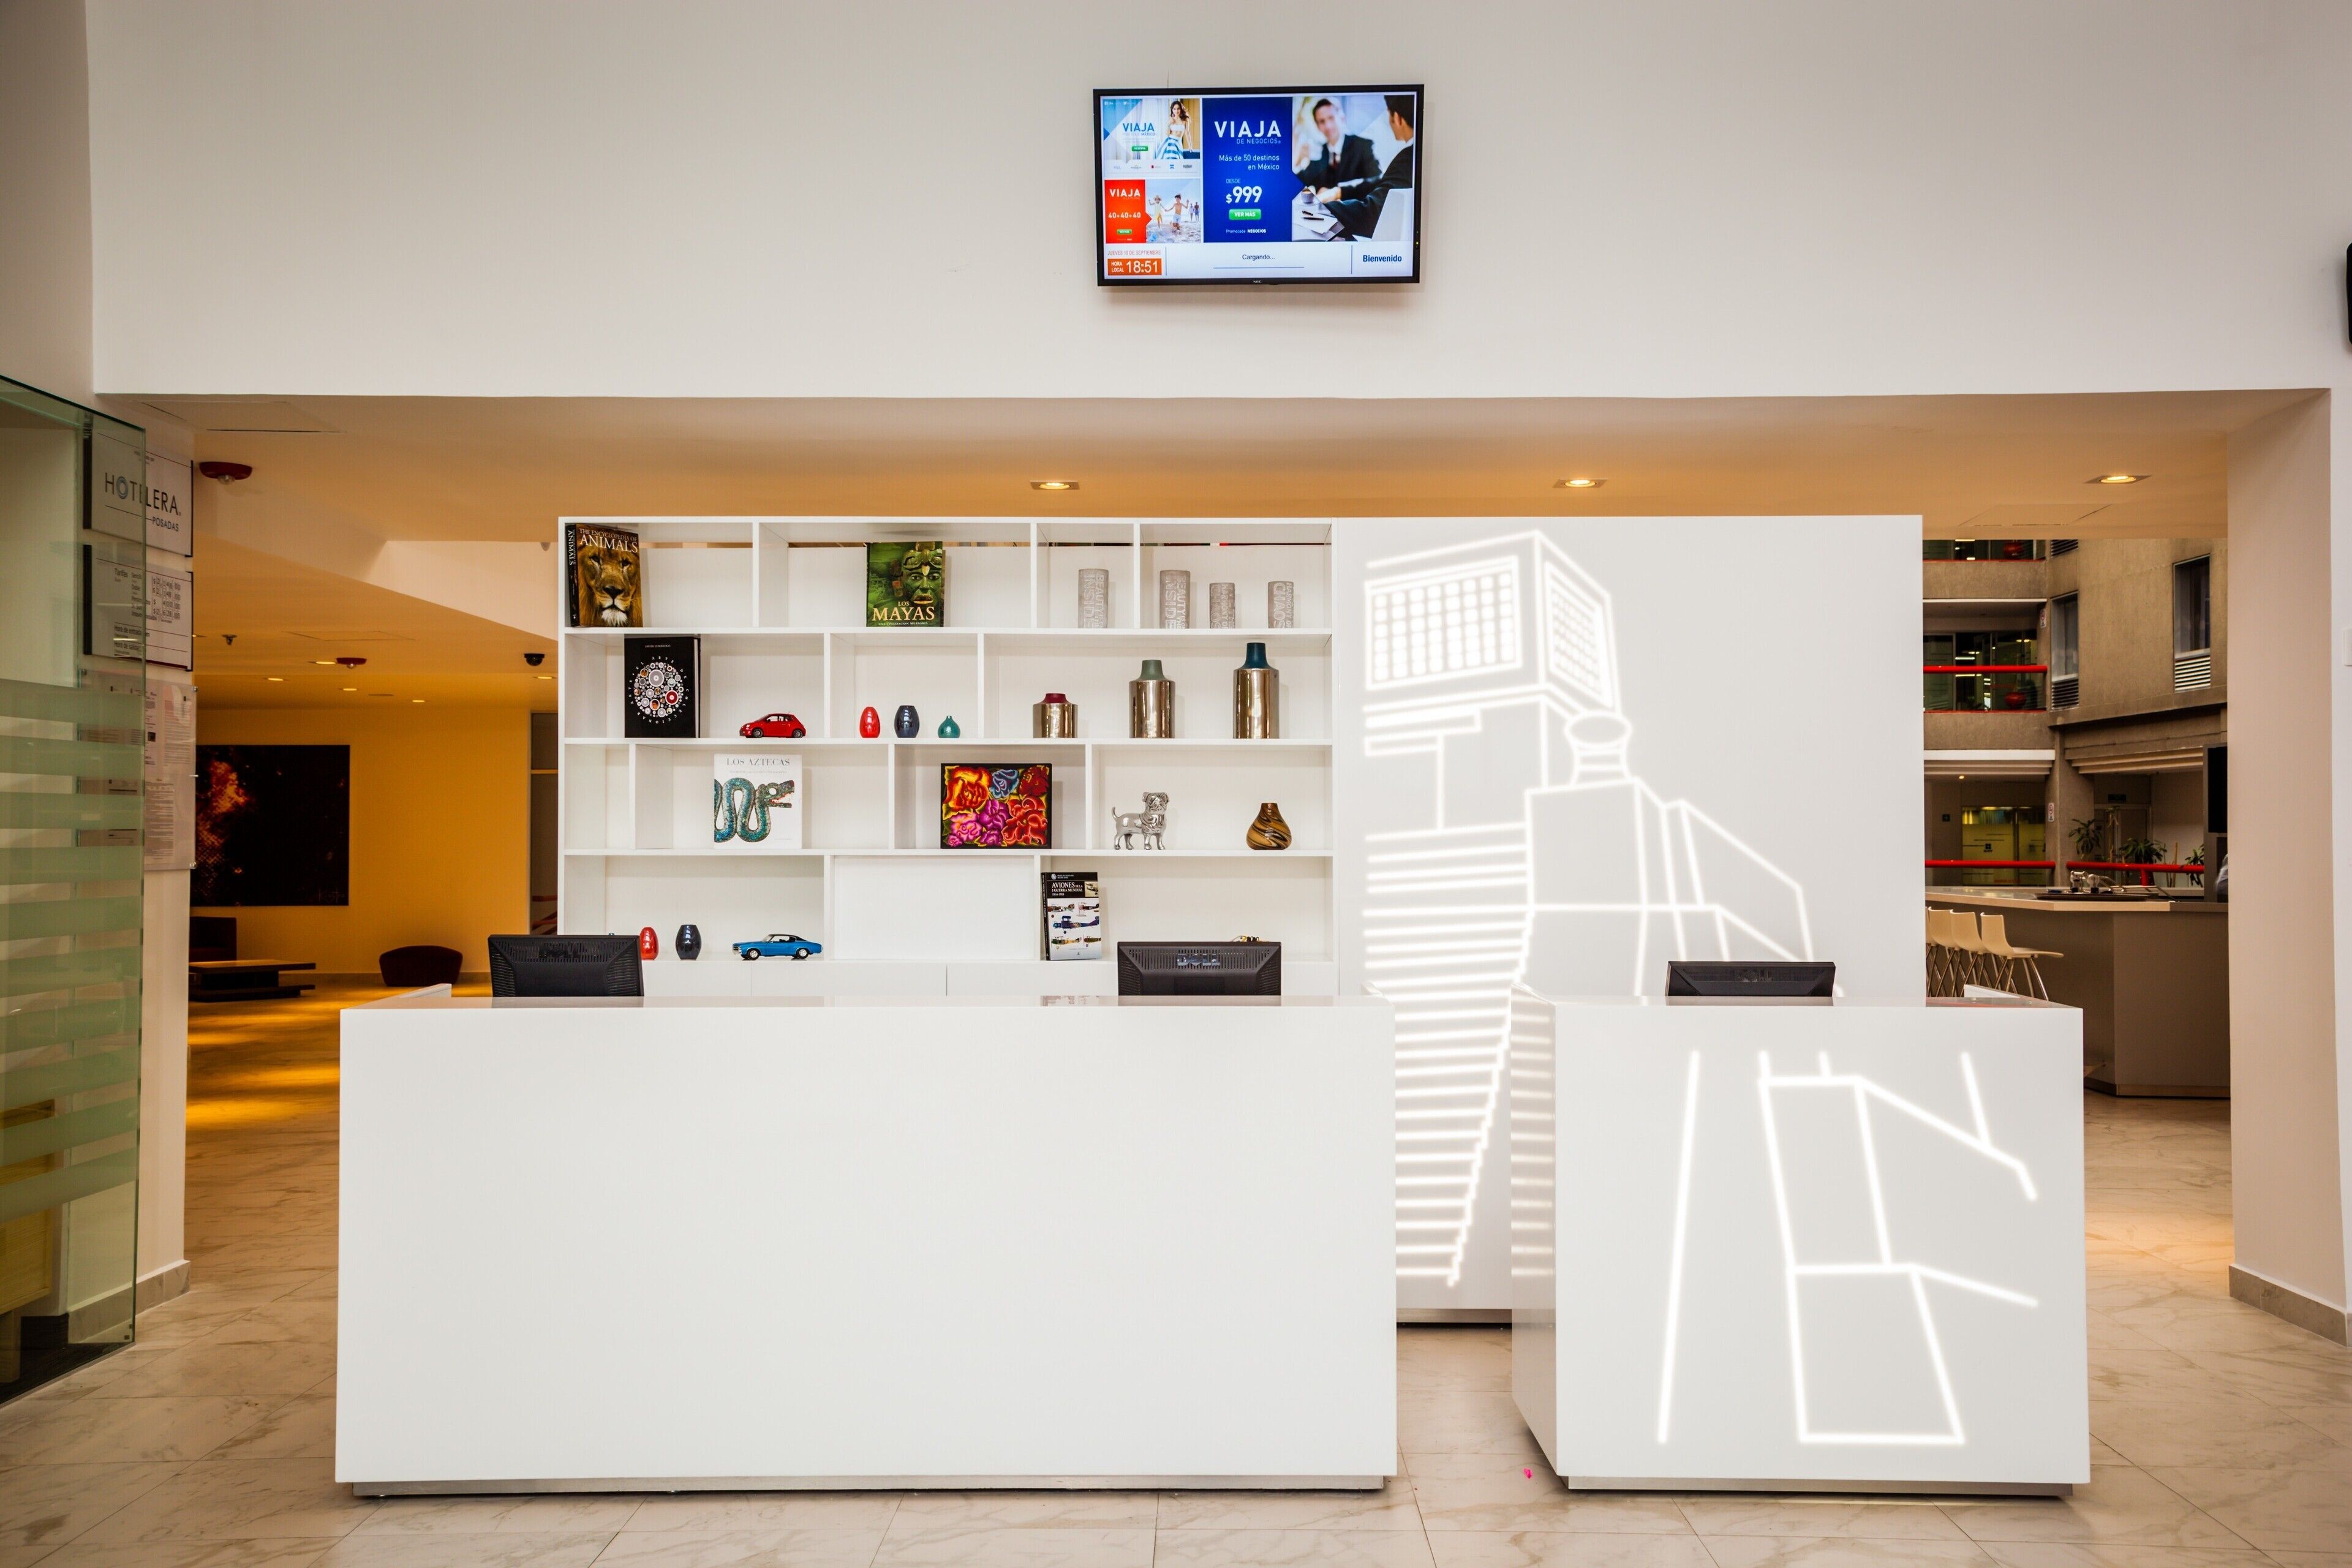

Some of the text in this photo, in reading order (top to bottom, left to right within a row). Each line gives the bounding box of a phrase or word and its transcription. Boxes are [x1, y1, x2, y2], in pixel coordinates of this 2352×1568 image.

[1123, 123, 1155, 132] VIAJA
[1214, 120, 1281, 138] VIAJA
[1226, 186, 1262, 204] $999
[1126, 260, 1158, 273] 18:51
[153, 516, 179, 532] POSADAS
[592, 530, 630, 541] ENCYCLOPEDIA
[579, 534, 638, 553] ANIMALS
[1177, 576, 1186, 615] BEAUTY
[872, 606, 935, 621] MAYAS
[1177, 953, 1221, 966] DELL
